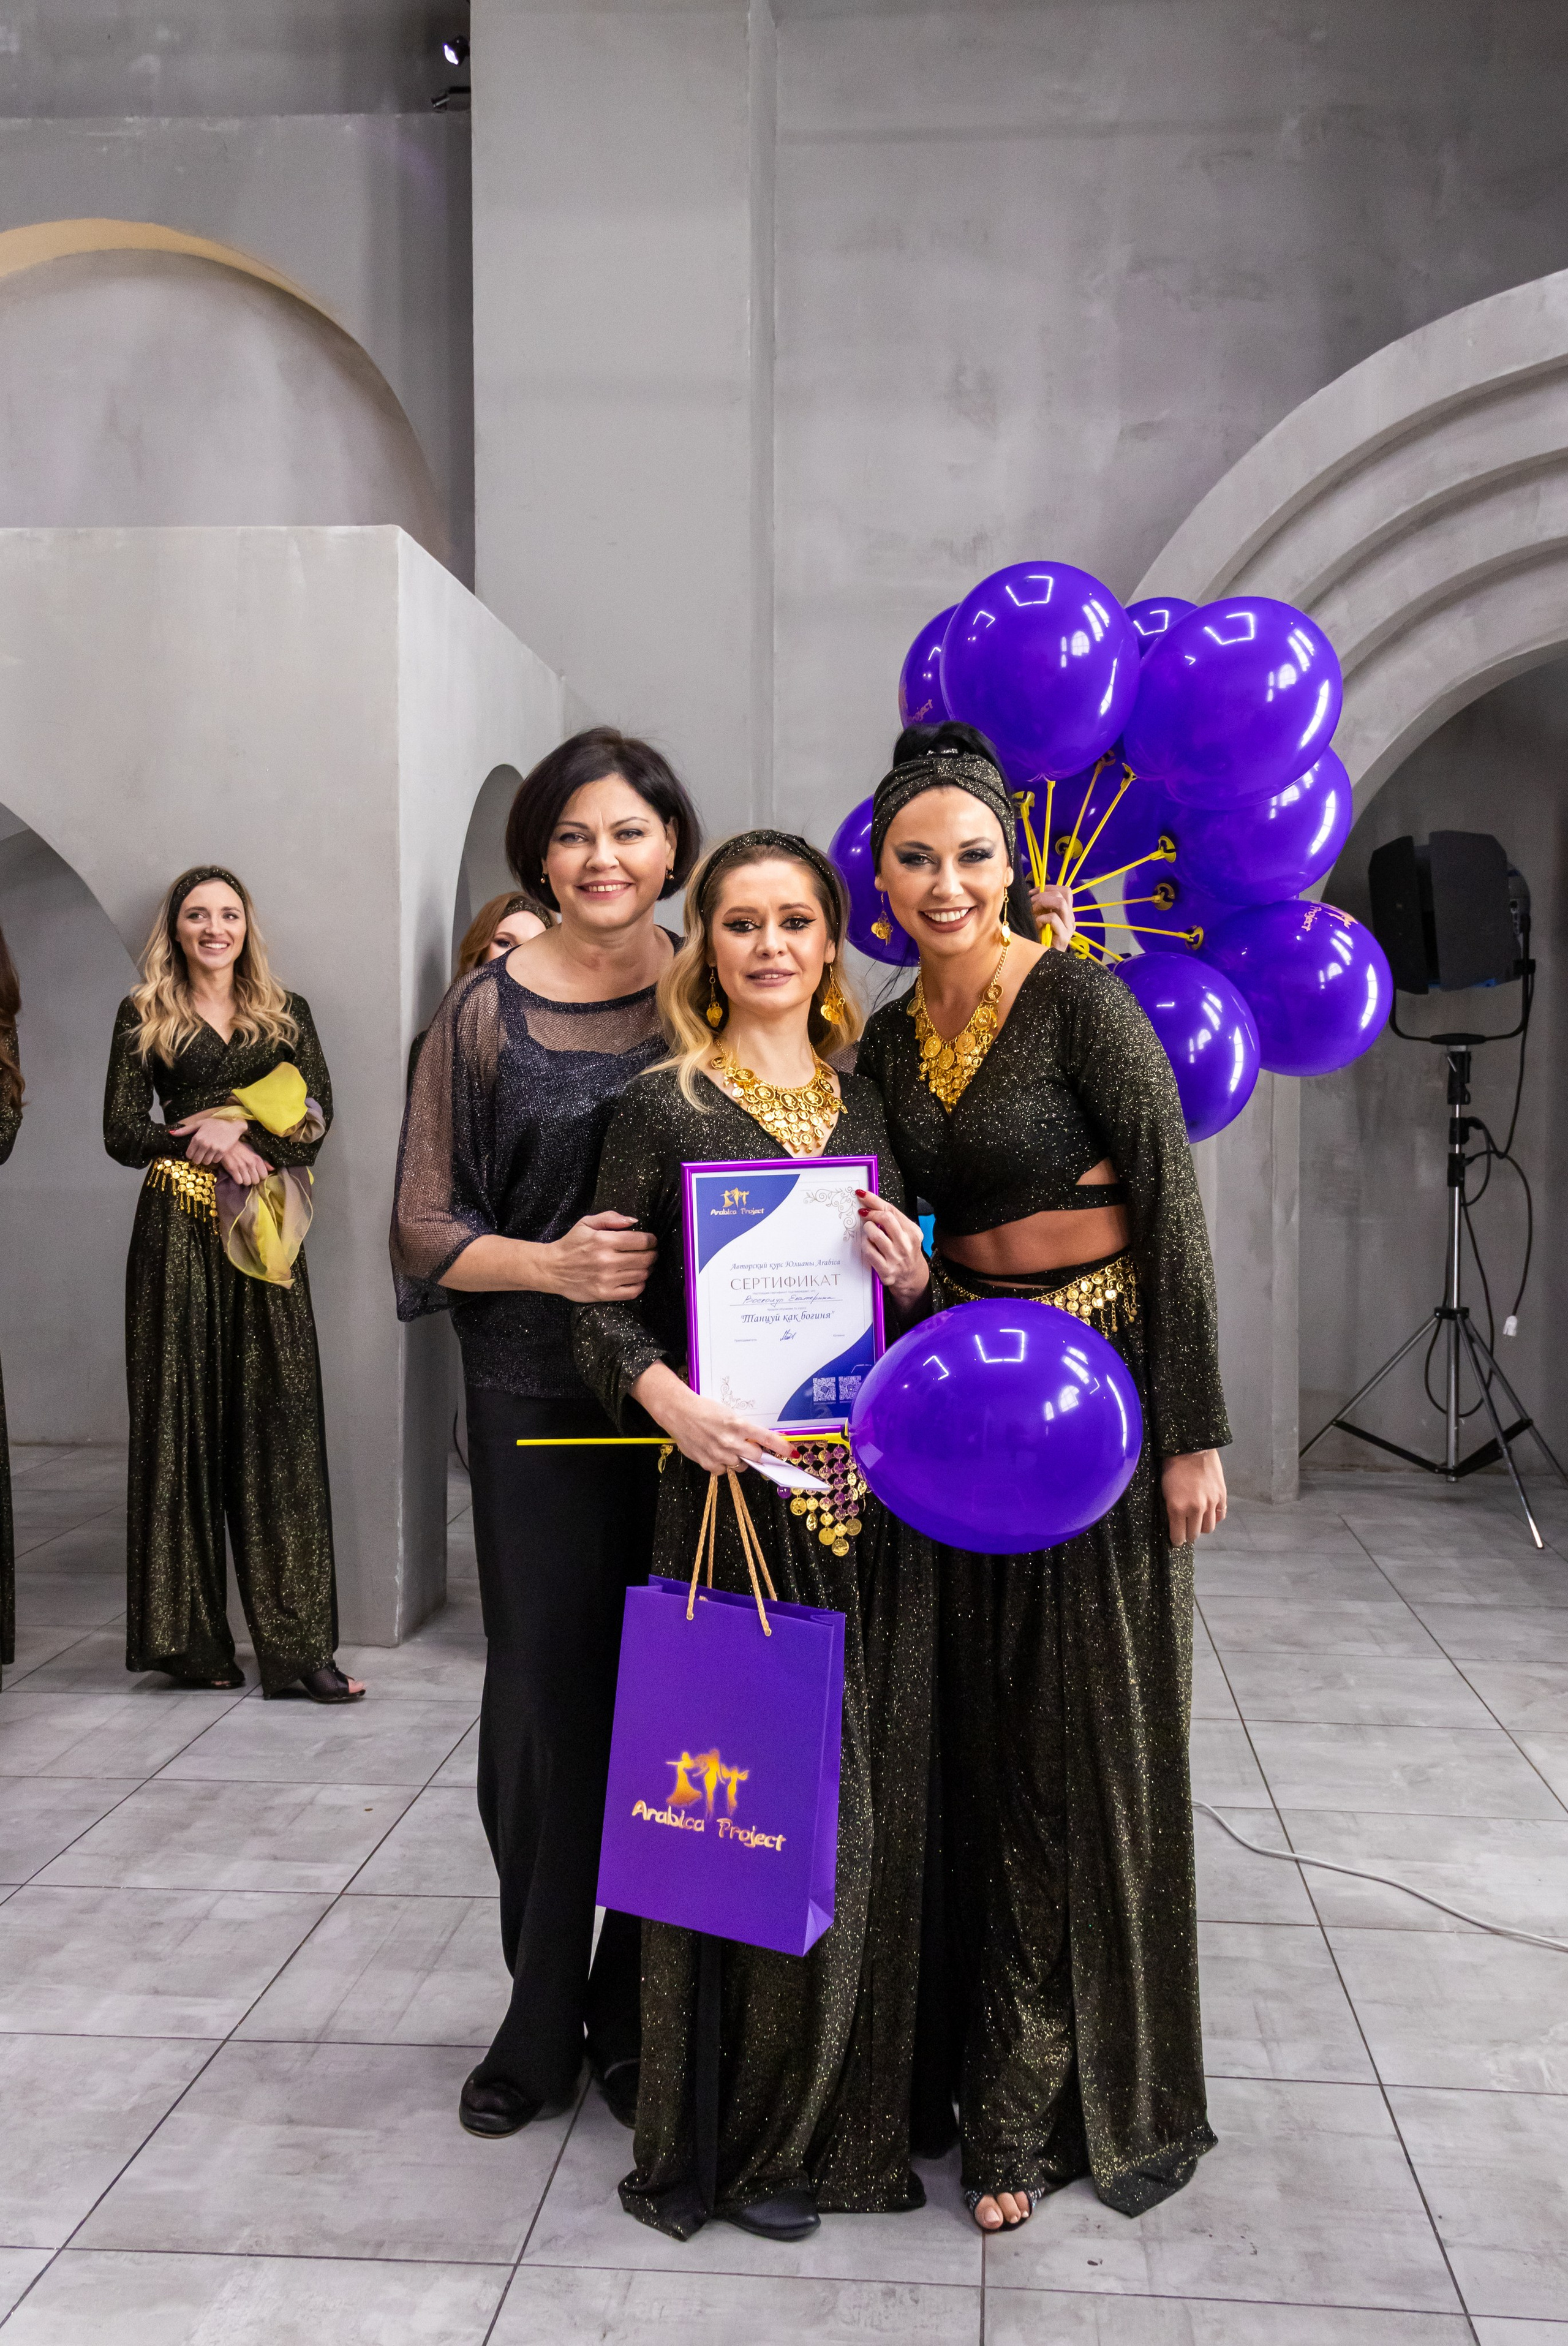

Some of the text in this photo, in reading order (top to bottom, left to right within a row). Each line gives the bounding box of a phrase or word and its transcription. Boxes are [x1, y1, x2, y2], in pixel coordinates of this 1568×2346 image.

[741, 1207, 764, 1215] Project
[730, 1262, 767, 1271] Авторский
[815, 1258, 840, 1267] Arabica
[730, 1273, 841, 1291] СЕРТИФИКАТ
[783, 1314, 801, 1323] как
[801, 1311, 835, 1320] богиня"
[631, 1800, 786, 1852] Arabica Project
